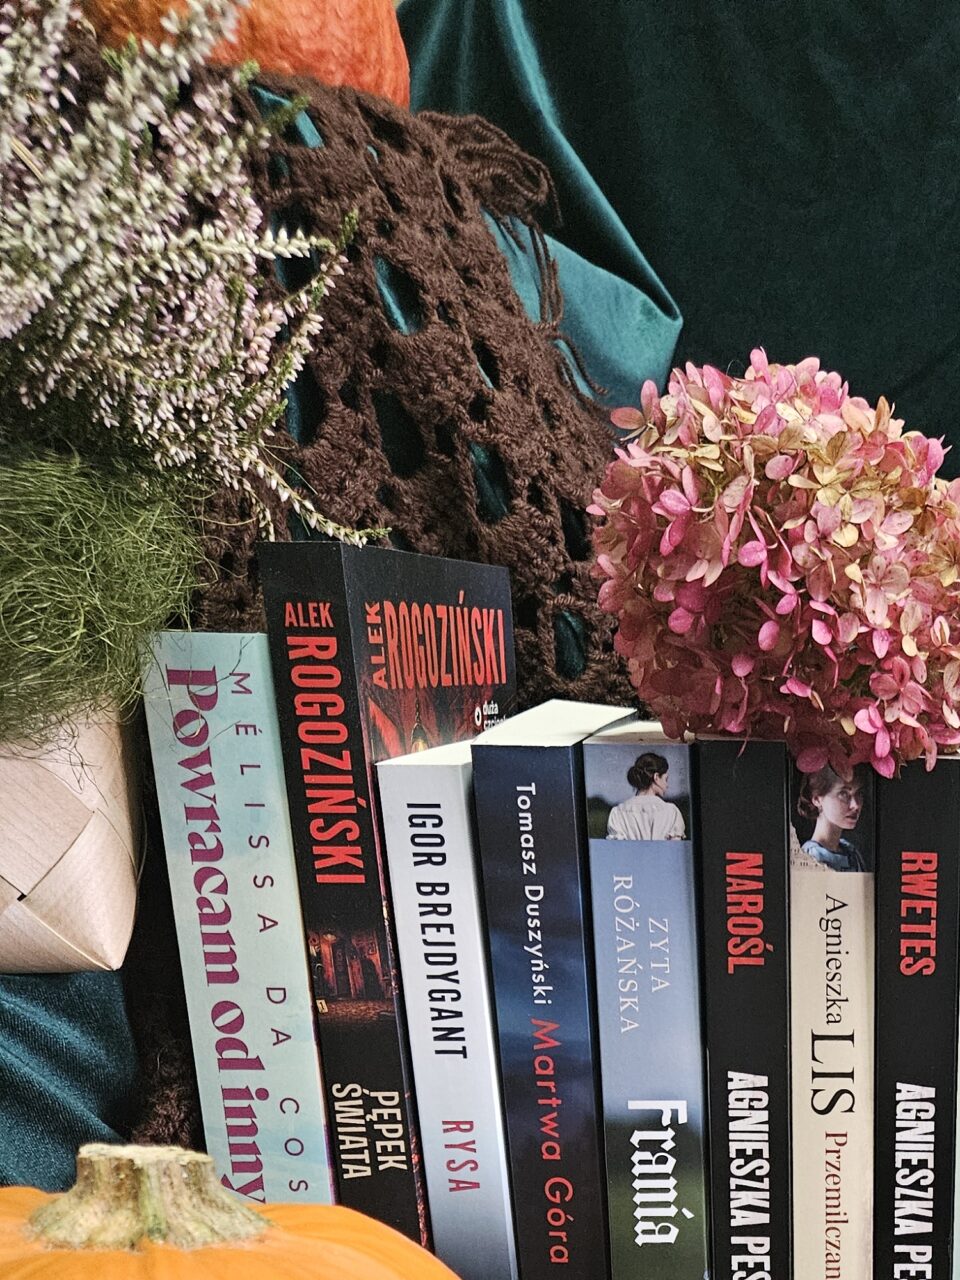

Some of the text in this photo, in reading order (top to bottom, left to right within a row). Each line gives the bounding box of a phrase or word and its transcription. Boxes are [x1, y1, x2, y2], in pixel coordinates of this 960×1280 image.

[284, 601, 335, 628] ALEK
[364, 601, 389, 690] ALEK
[383, 590, 507, 690] ROGOZIŃSKI
[286, 635, 368, 884] ROGOZIŃSKI
[165, 664, 240, 988] Powracam
[211, 1000, 265, 1072] od
[229, 672, 279, 933] MÉLISSA
[266, 987, 292, 1046] DA
[406, 802, 468, 1059] IGOR BREJDYGANT
[515, 782, 553, 1006] Tomasz Duszyński
[725, 852, 774, 975] NAROŚL
[899, 851, 939, 976] RWETES
[612, 874, 644, 1034] RÓŻAŃSKA
[648, 917, 671, 993] ZYTA
[810, 893, 856, 1116] Agnieszka LIS
[331, 1083, 372, 1180] ŚWIATA
[365, 1090, 408, 1172] PĘPEK
[441, 1120, 481, 1193] RYSA
[530, 1017, 575, 1264] Martwa Góra
[727, 1070, 771, 1227] AGNIESZKA
[893, 1082, 936, 1236] AGNIESZKA
